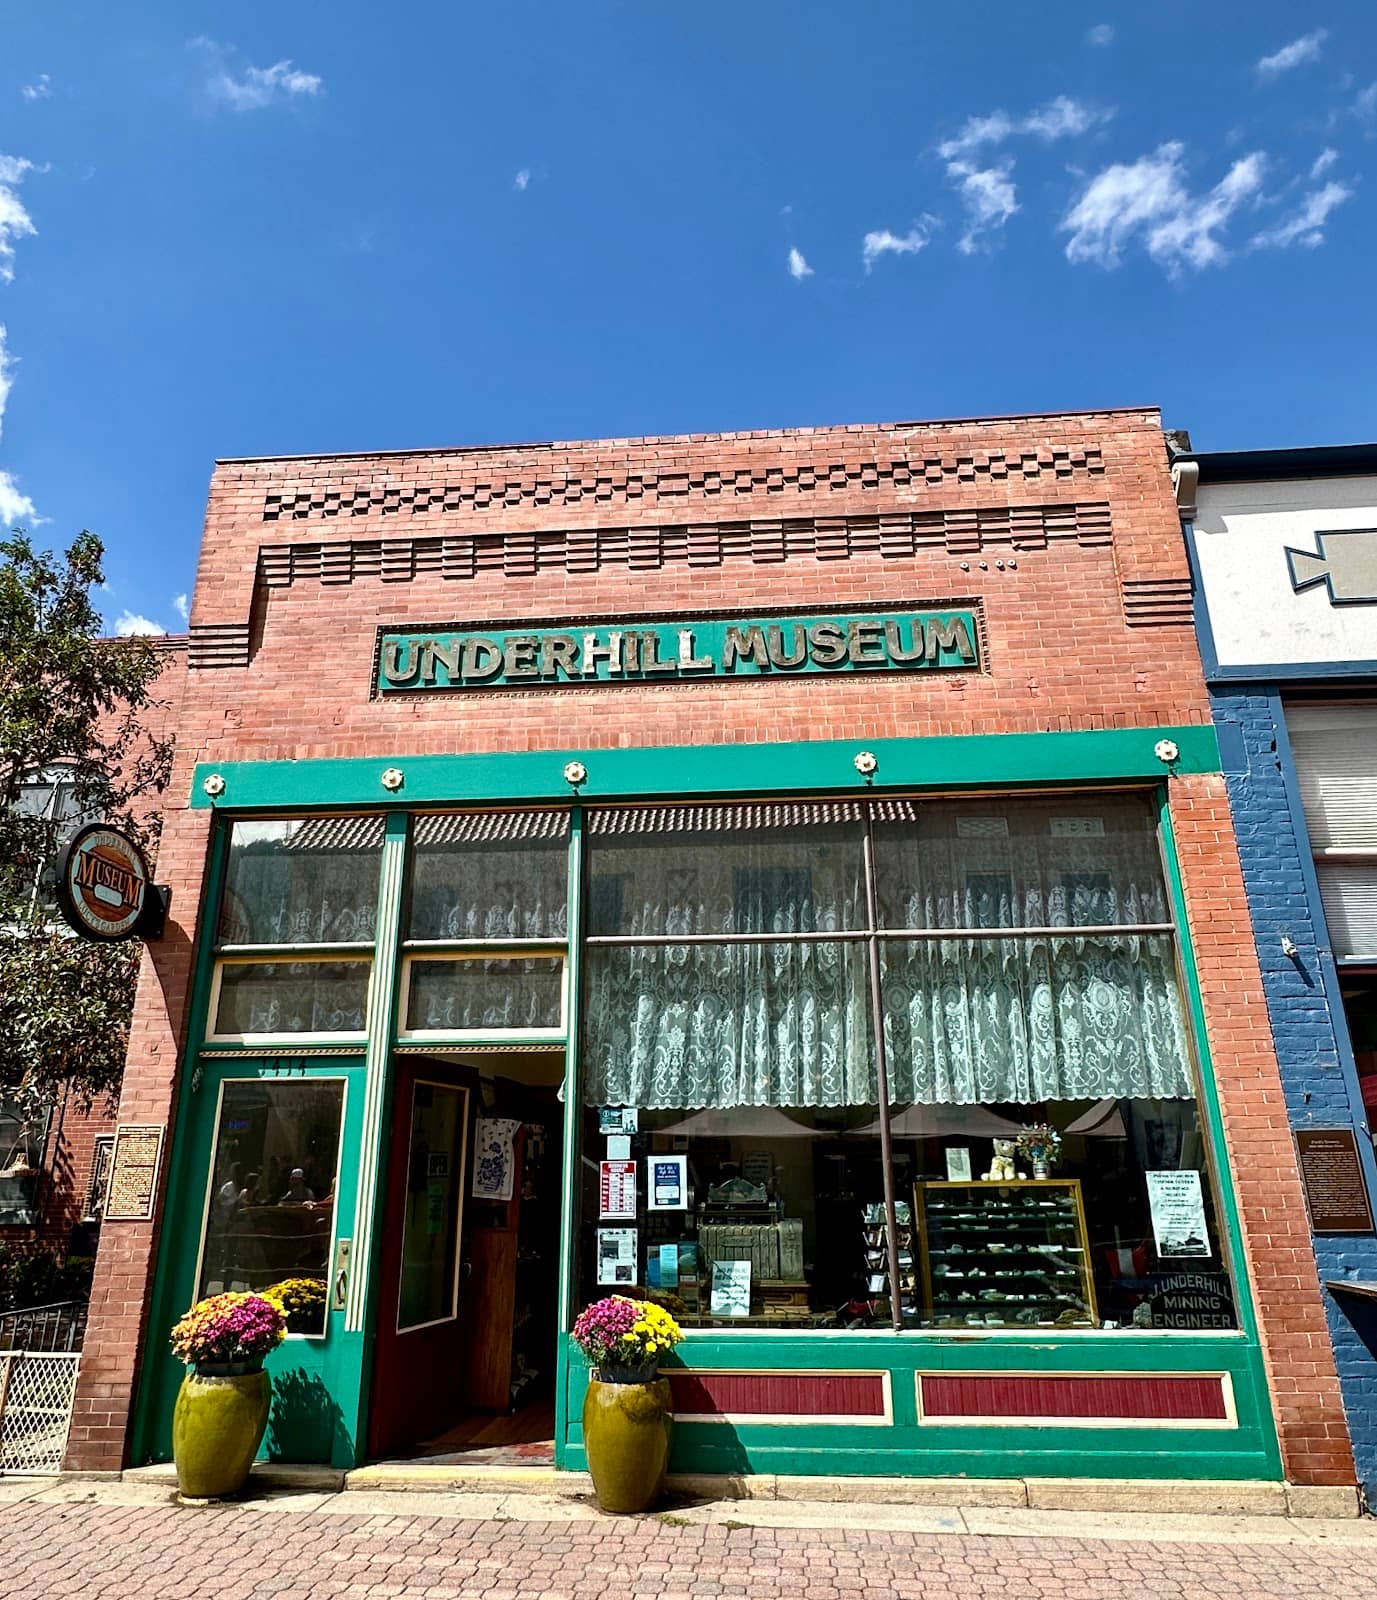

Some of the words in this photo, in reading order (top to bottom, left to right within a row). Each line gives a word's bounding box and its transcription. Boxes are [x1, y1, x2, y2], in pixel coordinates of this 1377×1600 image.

[384, 628, 713, 682] UNDERHILL
[726, 615, 976, 667] MUSEUM
[77, 853, 140, 907] MUSEUM
[1163, 1296, 1221, 1310] MINING
[1153, 1313, 1231, 1328] ENGINEER
